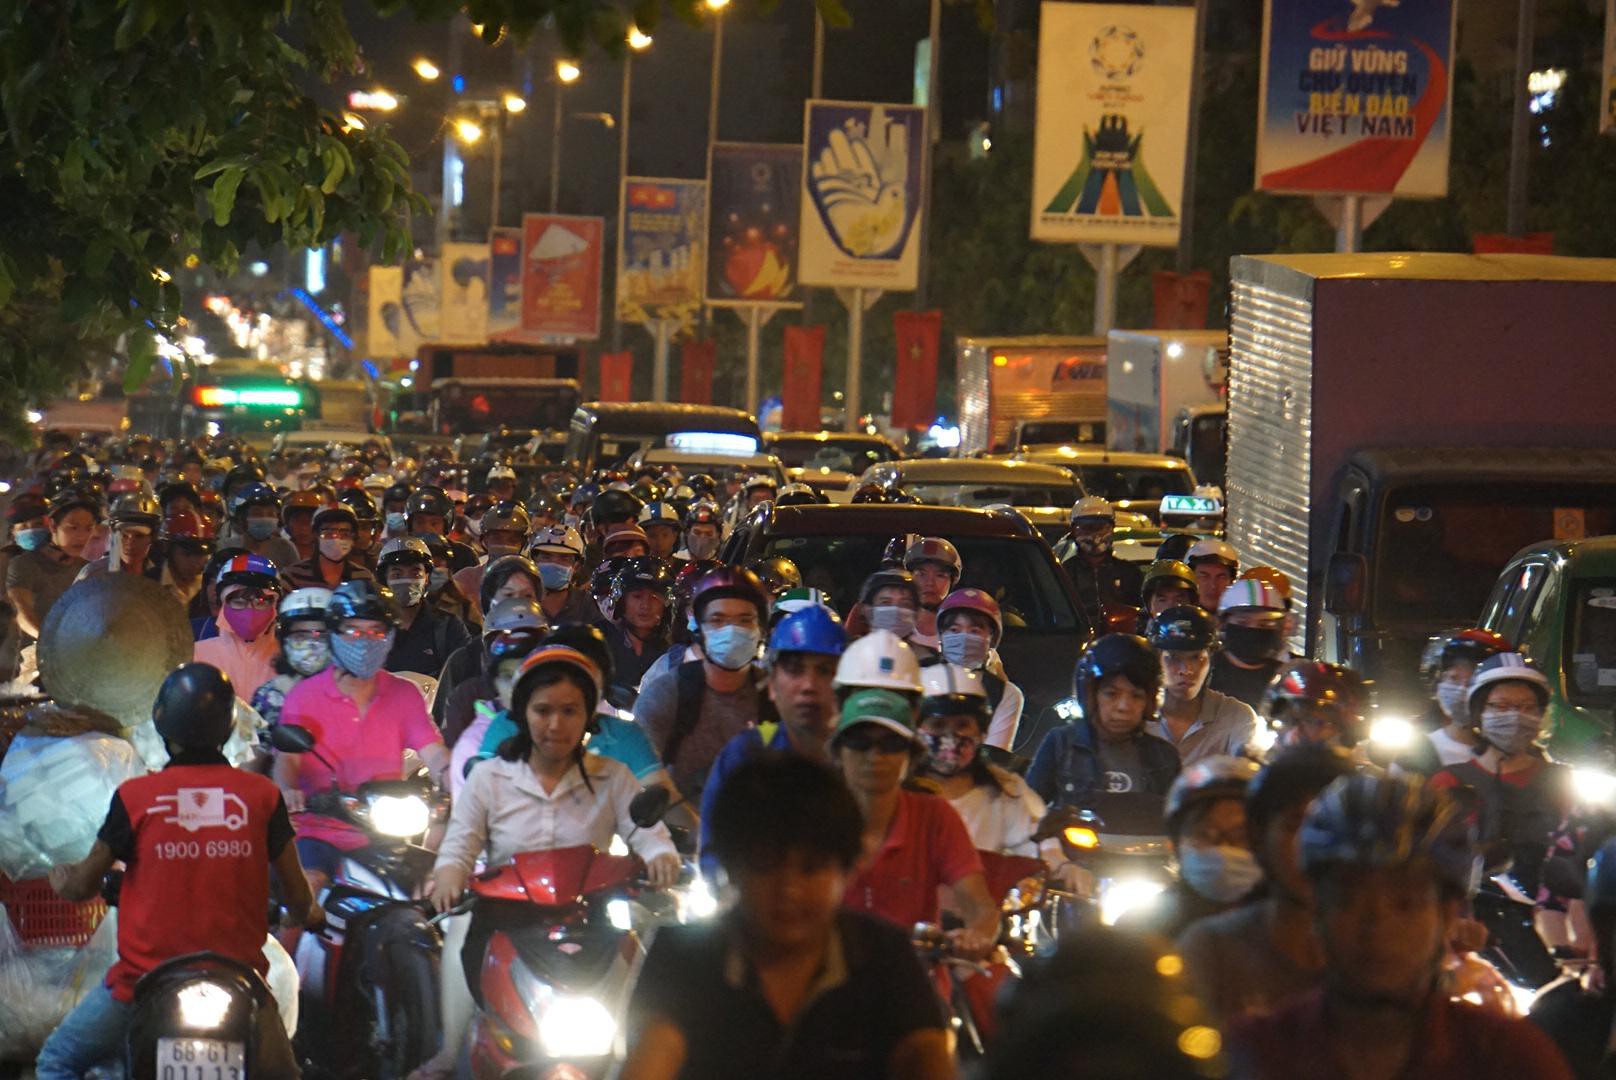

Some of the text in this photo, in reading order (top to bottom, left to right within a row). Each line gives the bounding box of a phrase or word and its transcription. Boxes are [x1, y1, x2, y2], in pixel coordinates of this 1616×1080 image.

[1297, 113, 1414, 138] VIỆT NAM
[1168, 497, 1213, 510] TAXI
[155, 839, 252, 860] 1900 6980
